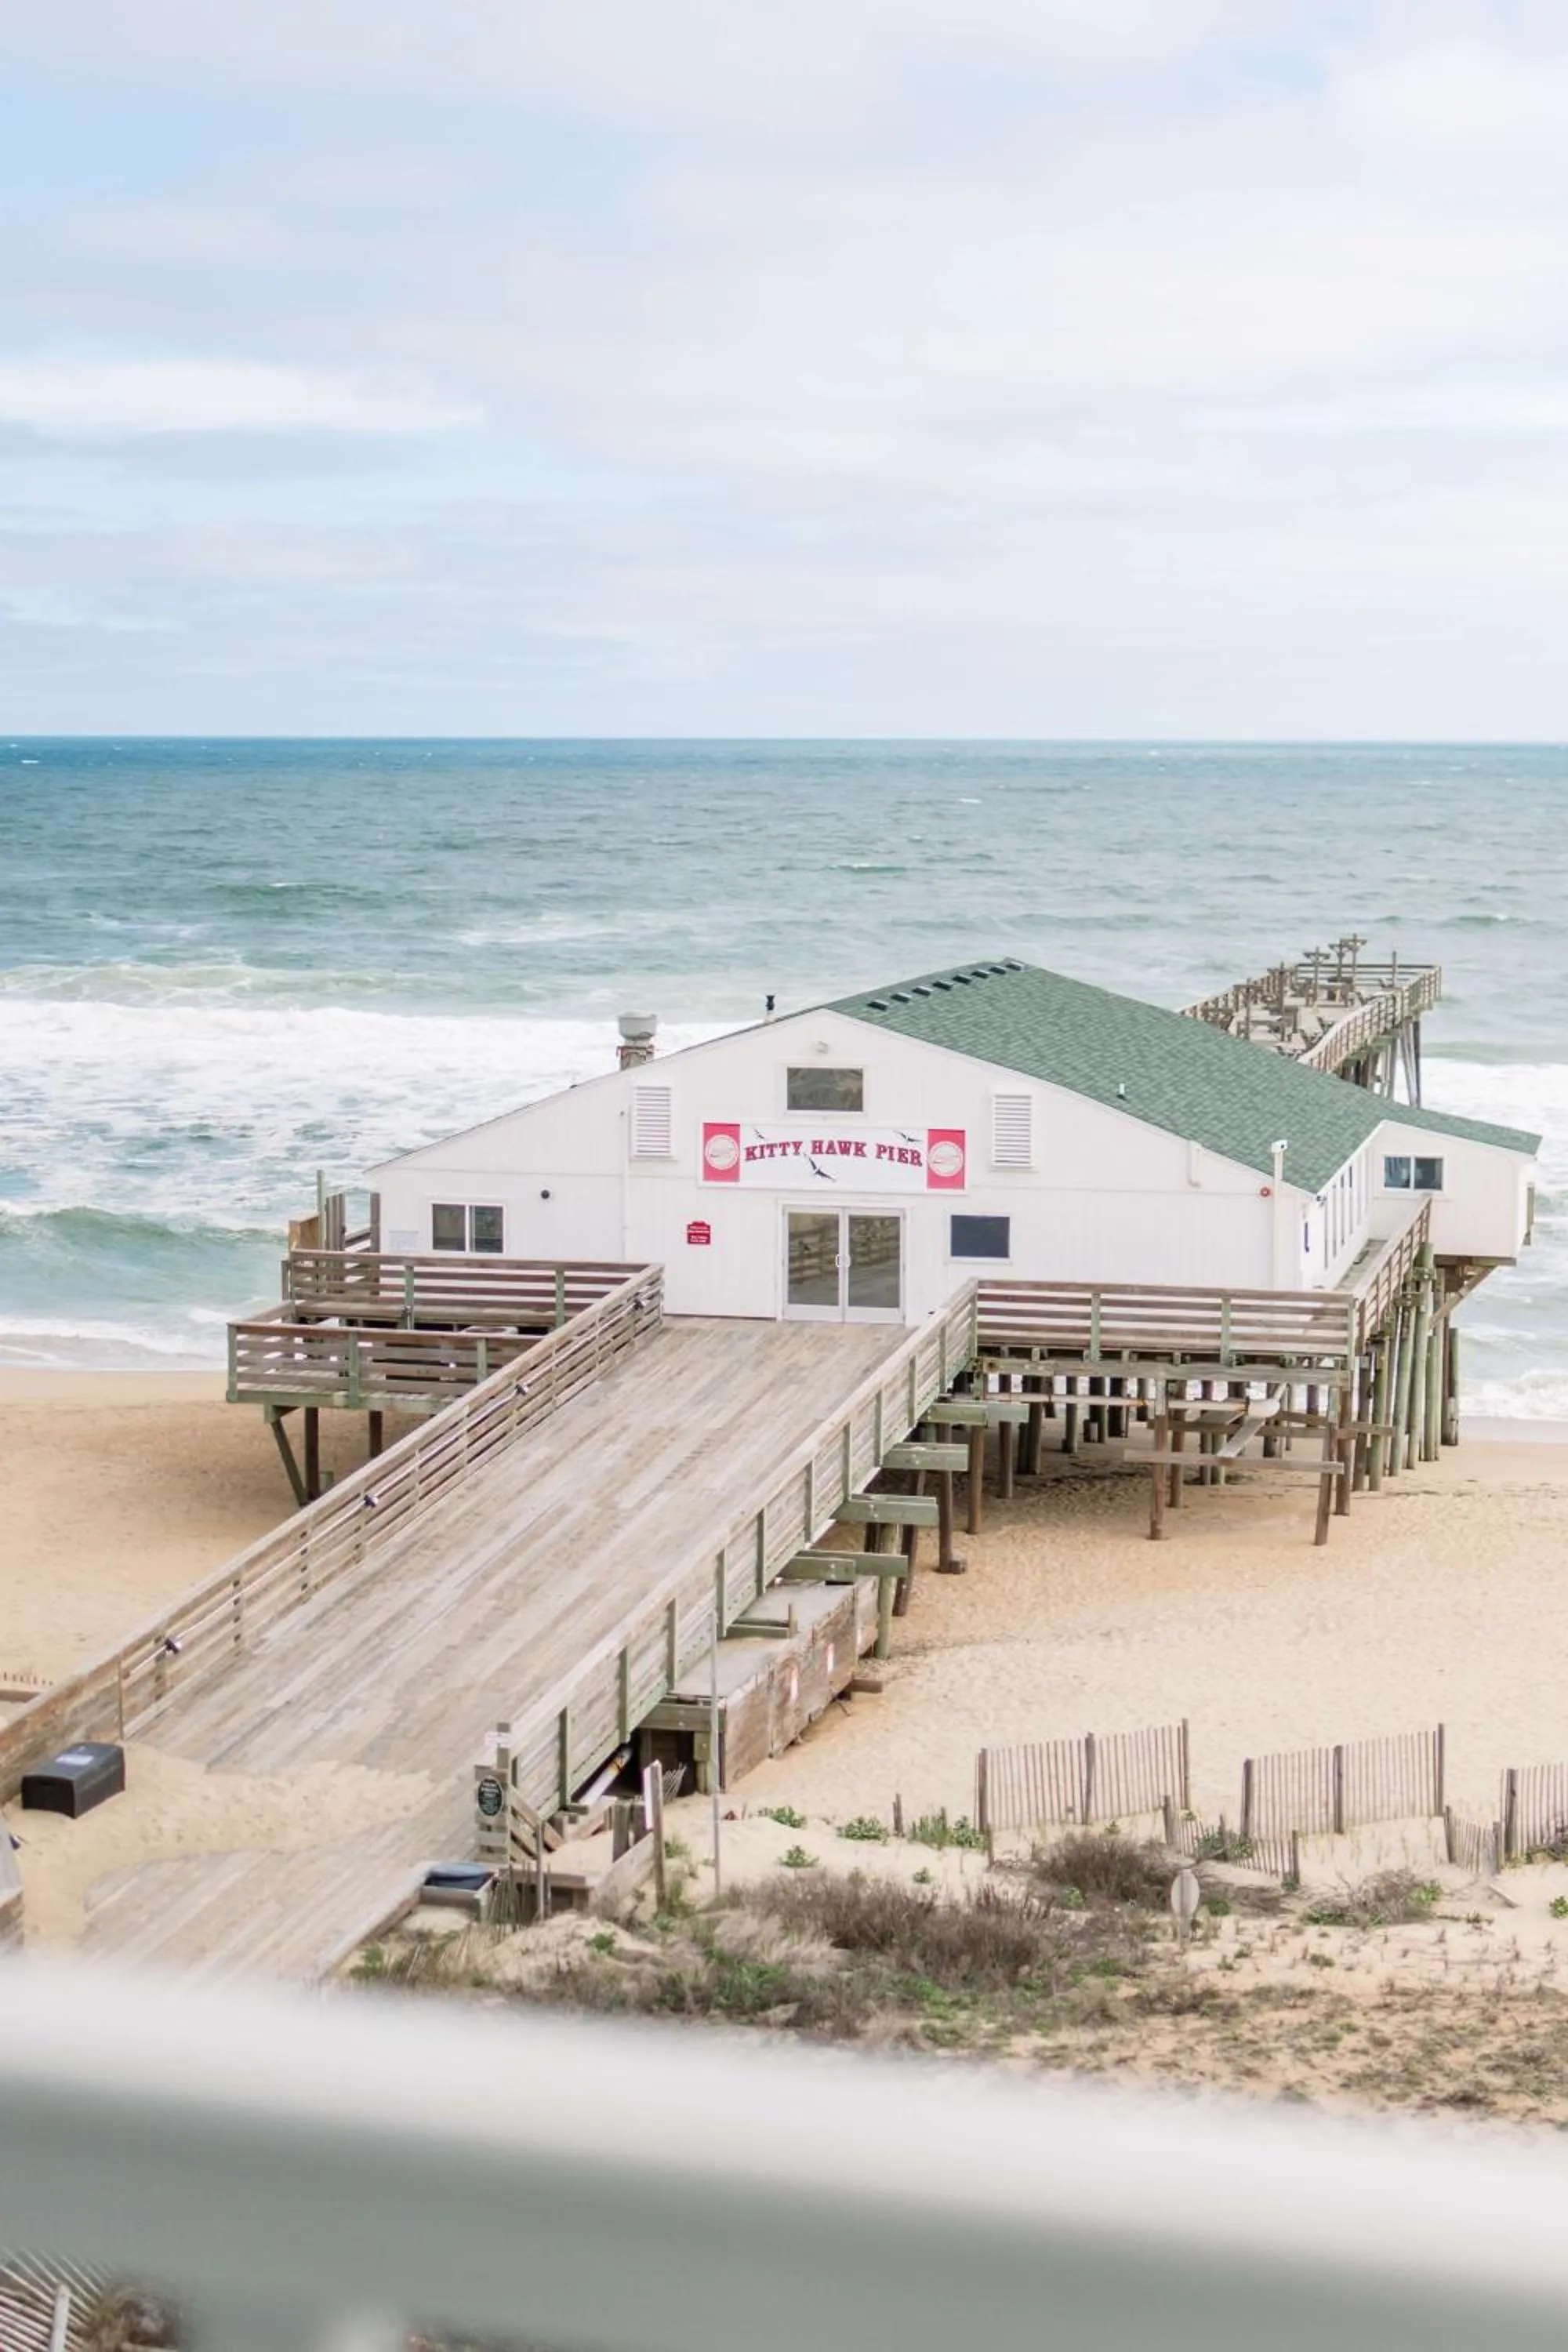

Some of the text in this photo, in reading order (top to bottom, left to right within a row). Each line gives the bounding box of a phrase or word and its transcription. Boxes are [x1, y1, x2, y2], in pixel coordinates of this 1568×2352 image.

[745, 1141, 803, 1161] KITTY
[811, 1139, 866, 1157] HAWK
[876, 1143, 922, 1166] PIER
